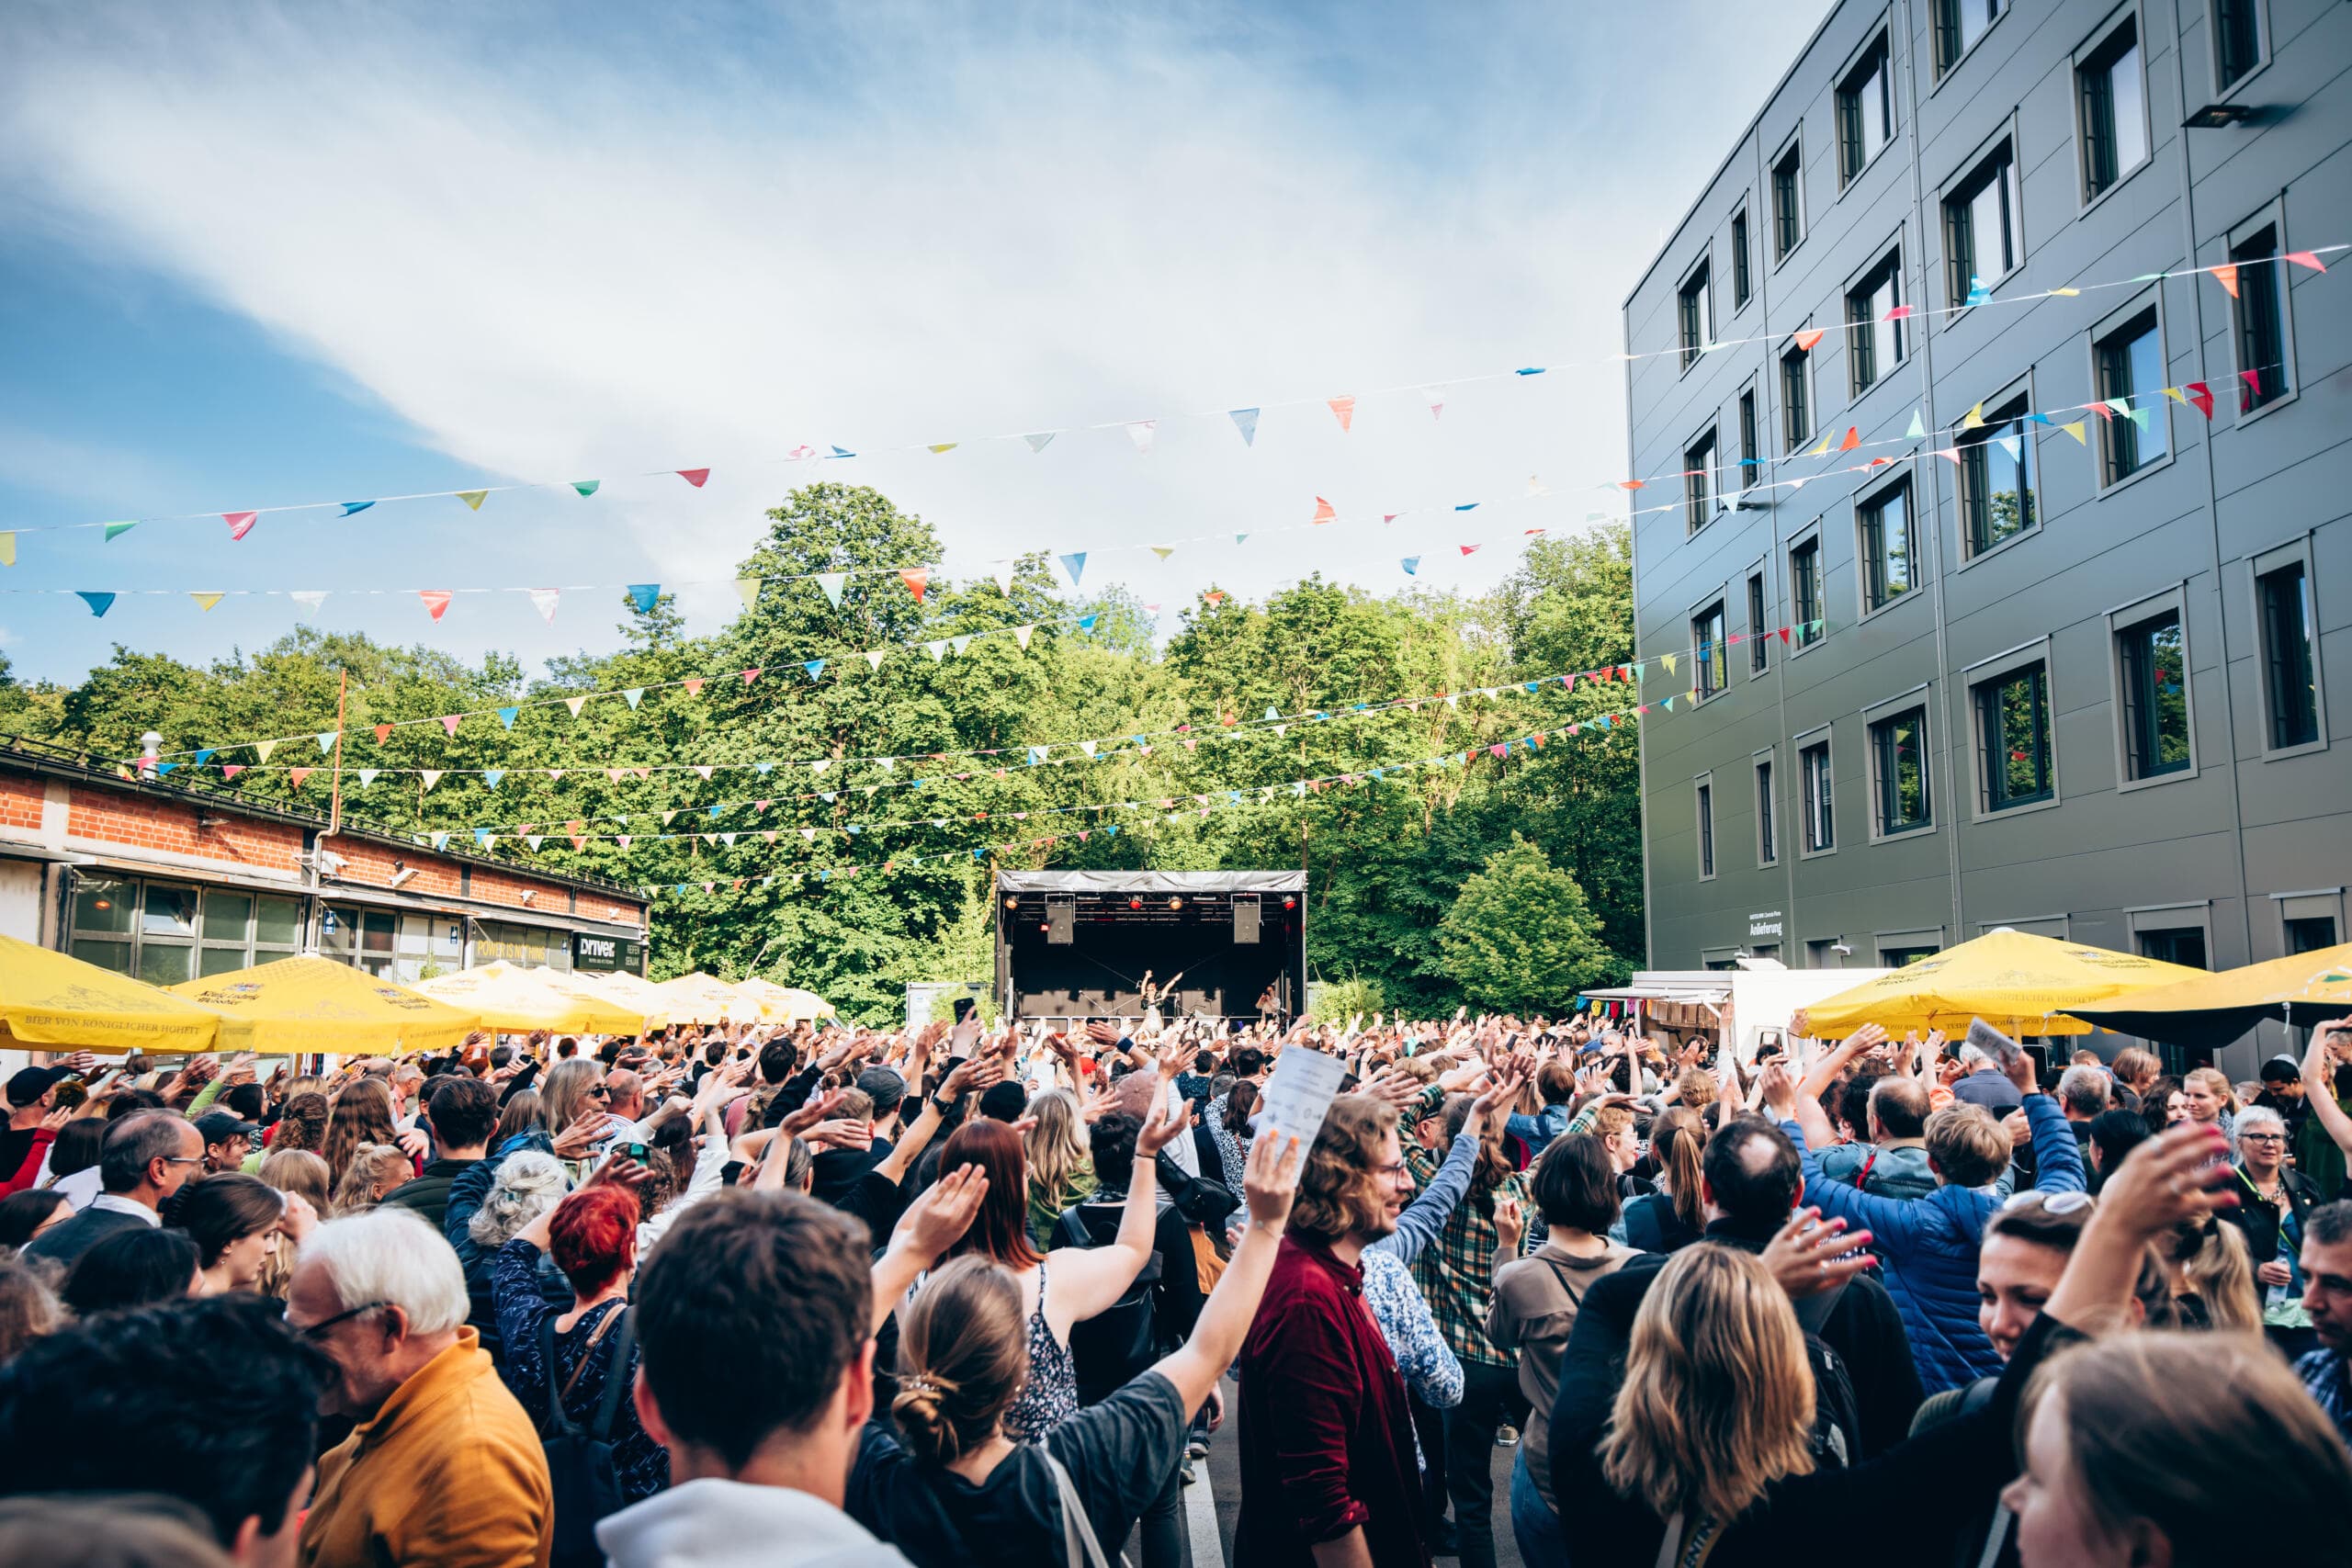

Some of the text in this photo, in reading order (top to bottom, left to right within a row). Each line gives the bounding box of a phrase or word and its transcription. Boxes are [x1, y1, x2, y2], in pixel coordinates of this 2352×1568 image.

[478, 940, 505, 958] POWER
[25, 1014, 51, 1025] BIER
[55, 1016, 79, 1027] VON
[161, 1024, 201, 1035] HOHEIT
